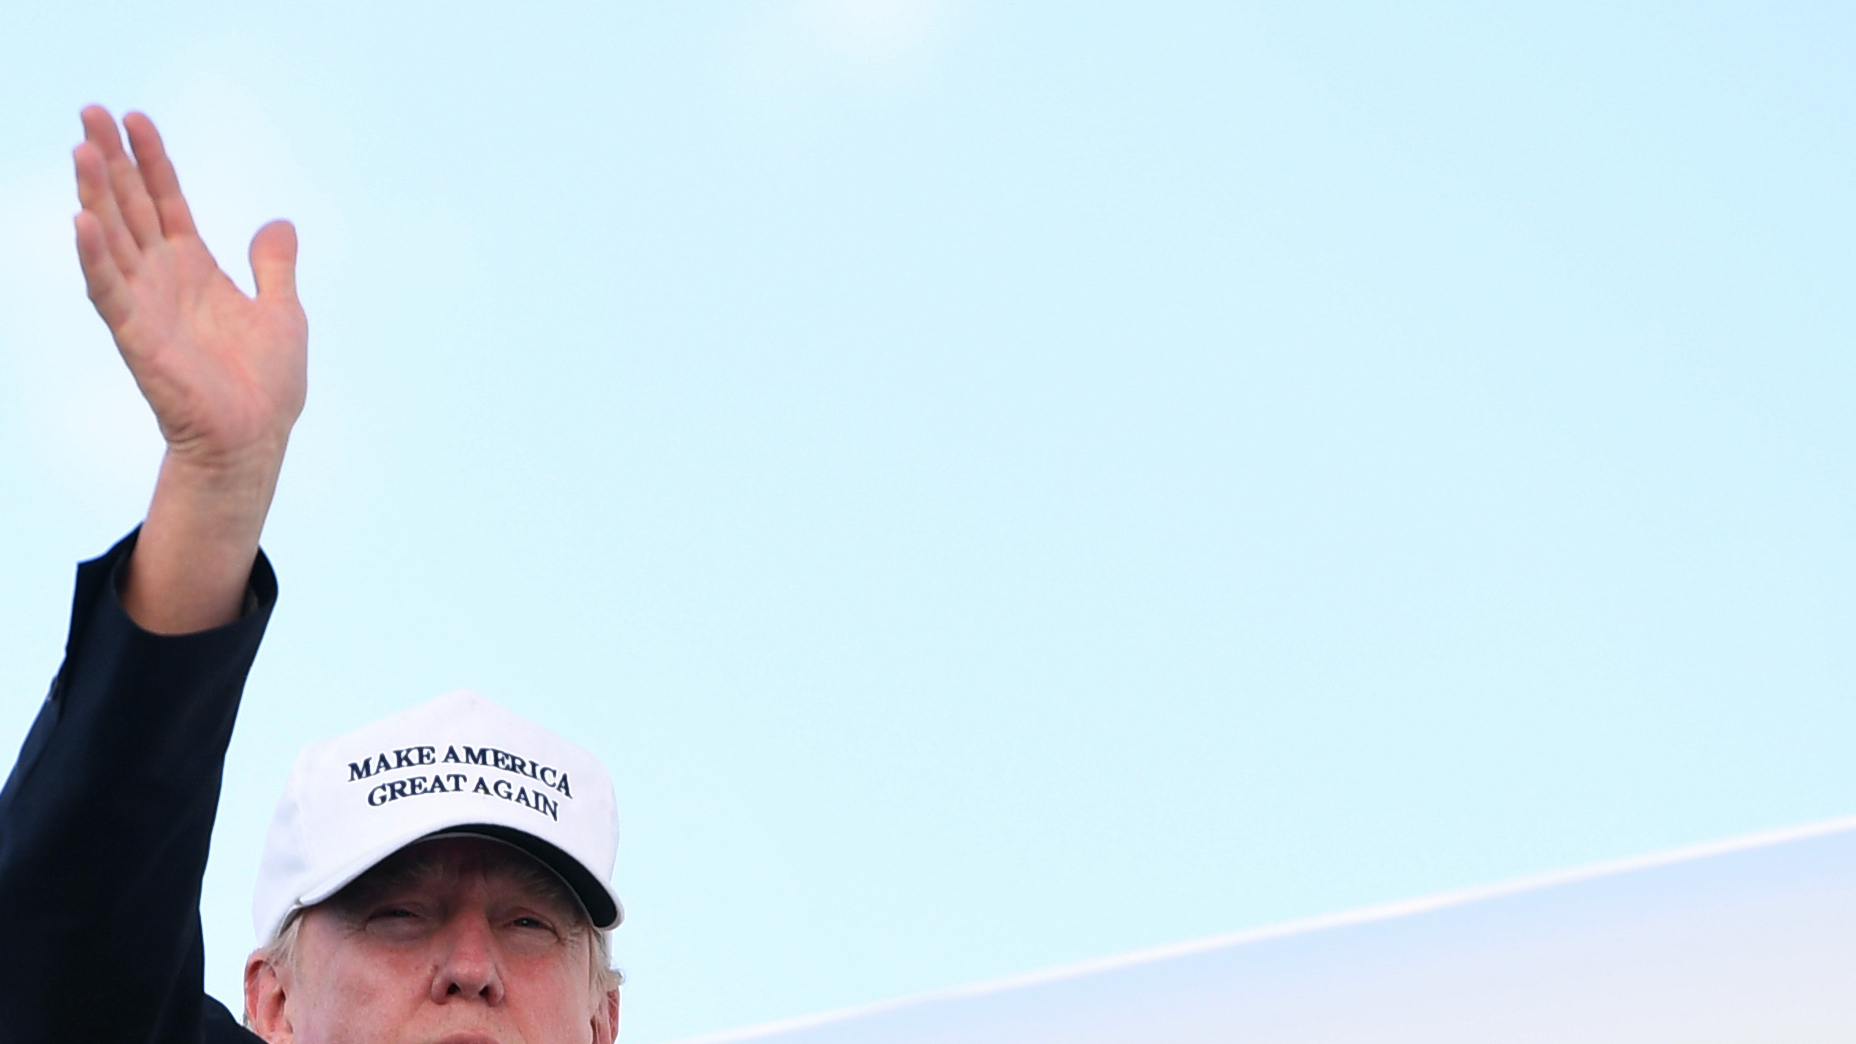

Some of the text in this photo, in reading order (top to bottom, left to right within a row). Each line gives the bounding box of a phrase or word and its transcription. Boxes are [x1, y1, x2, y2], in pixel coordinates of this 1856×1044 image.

[348, 745, 573, 799] MAKE AMERICA
[367, 774, 559, 822] GREAT AGAIN
